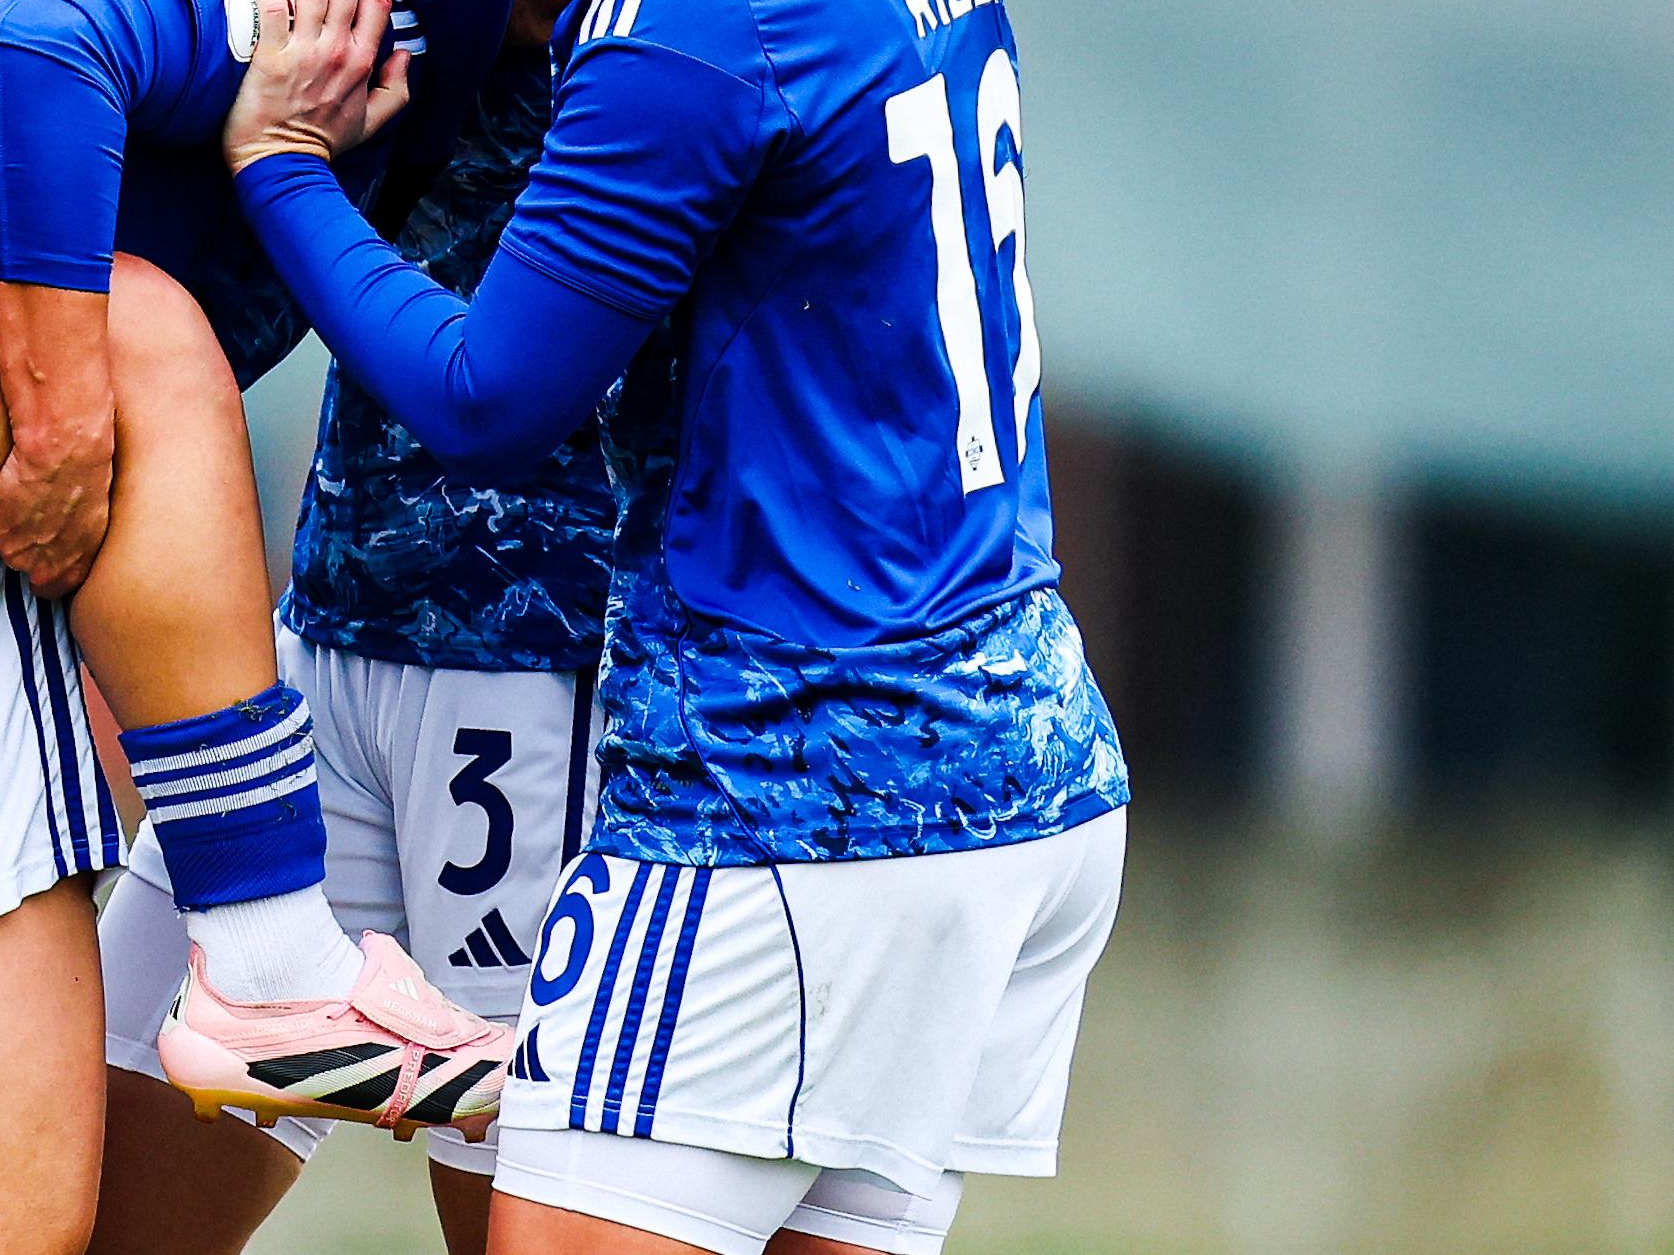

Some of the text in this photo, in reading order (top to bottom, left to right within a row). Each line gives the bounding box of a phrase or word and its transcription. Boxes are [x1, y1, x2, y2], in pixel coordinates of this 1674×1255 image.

[438, 728, 514, 895] 3
[530, 853, 610, 1006] 6
[383, 999, 438, 1030] BECKHAM
